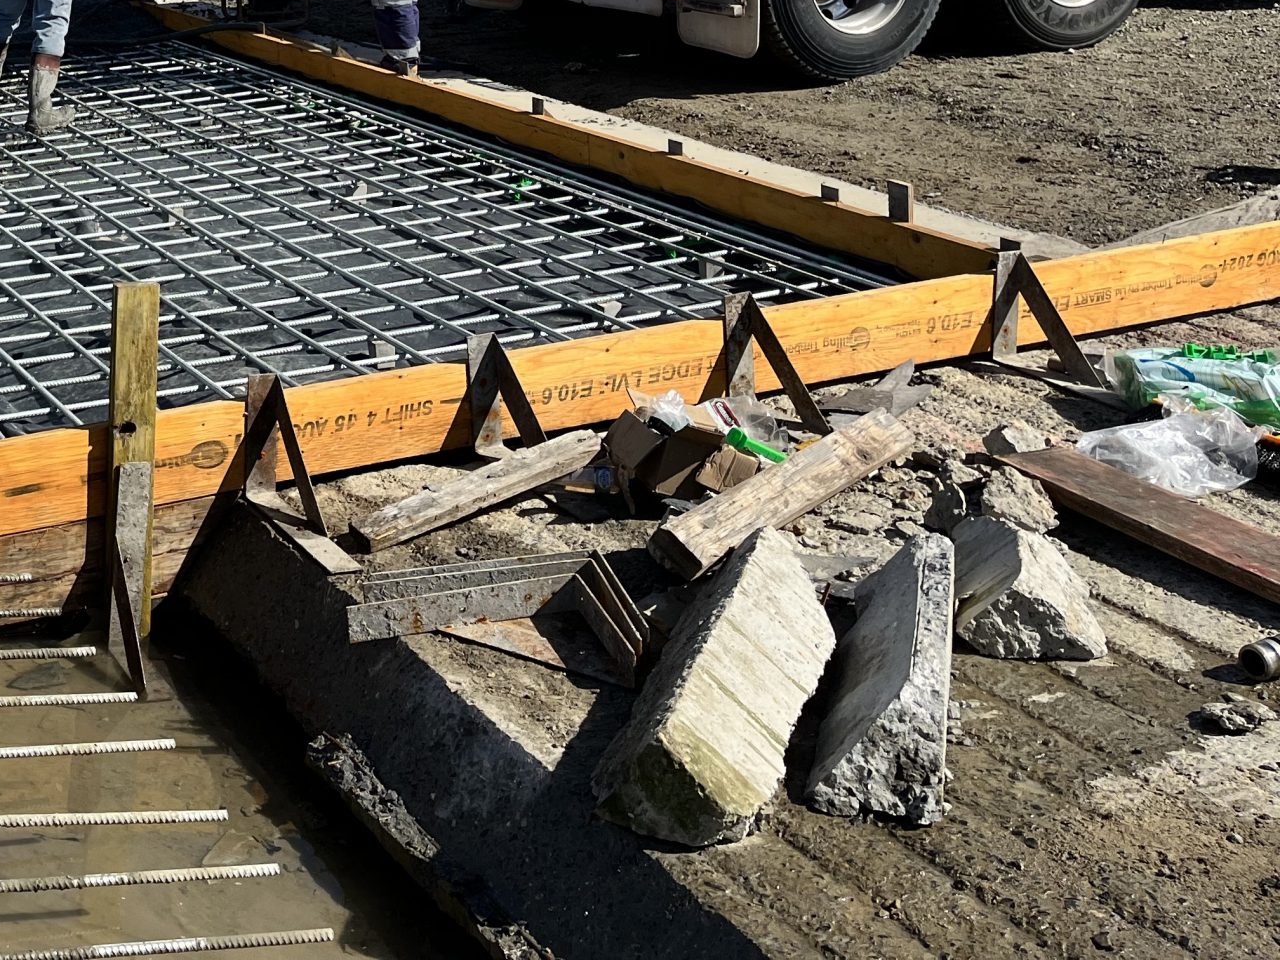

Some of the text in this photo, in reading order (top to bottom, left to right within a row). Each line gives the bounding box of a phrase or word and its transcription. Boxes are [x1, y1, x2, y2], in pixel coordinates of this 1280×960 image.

[1073, 290, 1112, 307] SMART
[647, 357, 704, 384] EDGE
[541, 379, 593, 405] E10.6
[367, 410, 377, 427] 4
[380, 399, 434, 425] SHIFT
